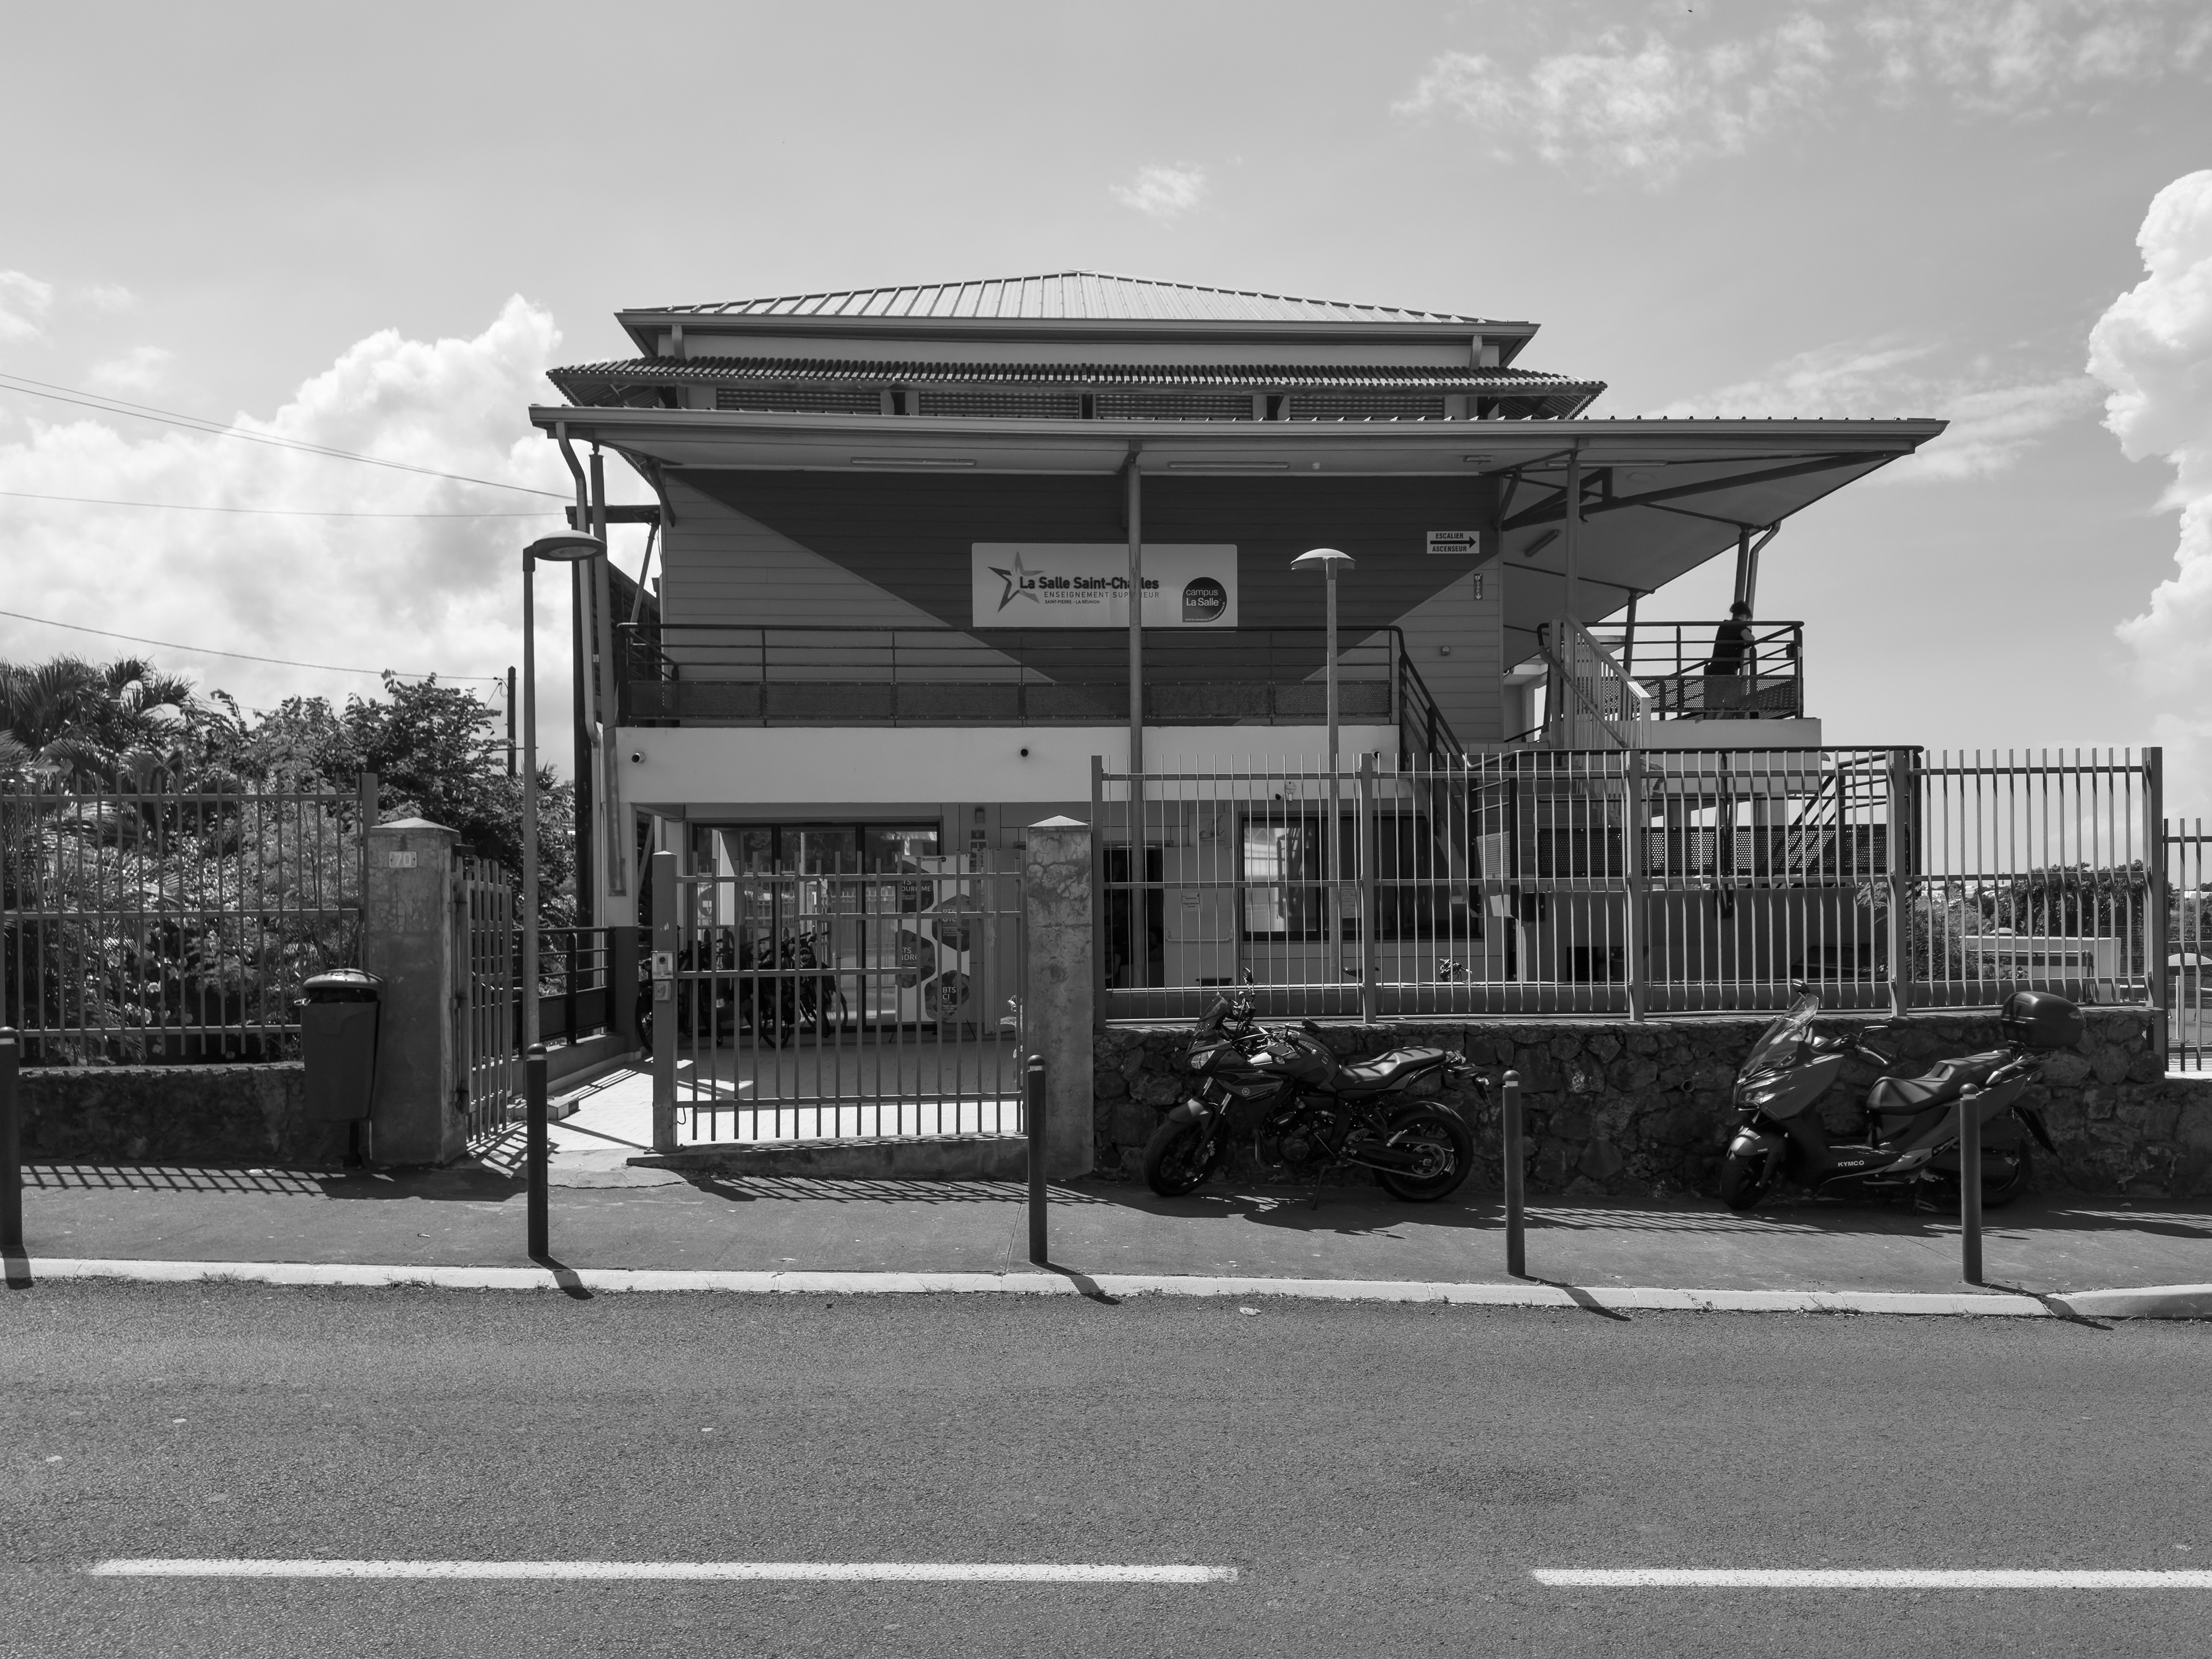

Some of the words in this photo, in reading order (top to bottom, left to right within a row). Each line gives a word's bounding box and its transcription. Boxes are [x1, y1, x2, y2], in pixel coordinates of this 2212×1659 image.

[1020, 576, 1035, 589] La
[1039, 577, 1070, 589] Salle
[1073, 577, 1159, 589] Saint-Chles
[1186, 589, 1218, 597] campus
[1186, 597, 1196, 606] La
[1198, 597, 1219, 606] Salle
[394, 853, 411, 867] 70
